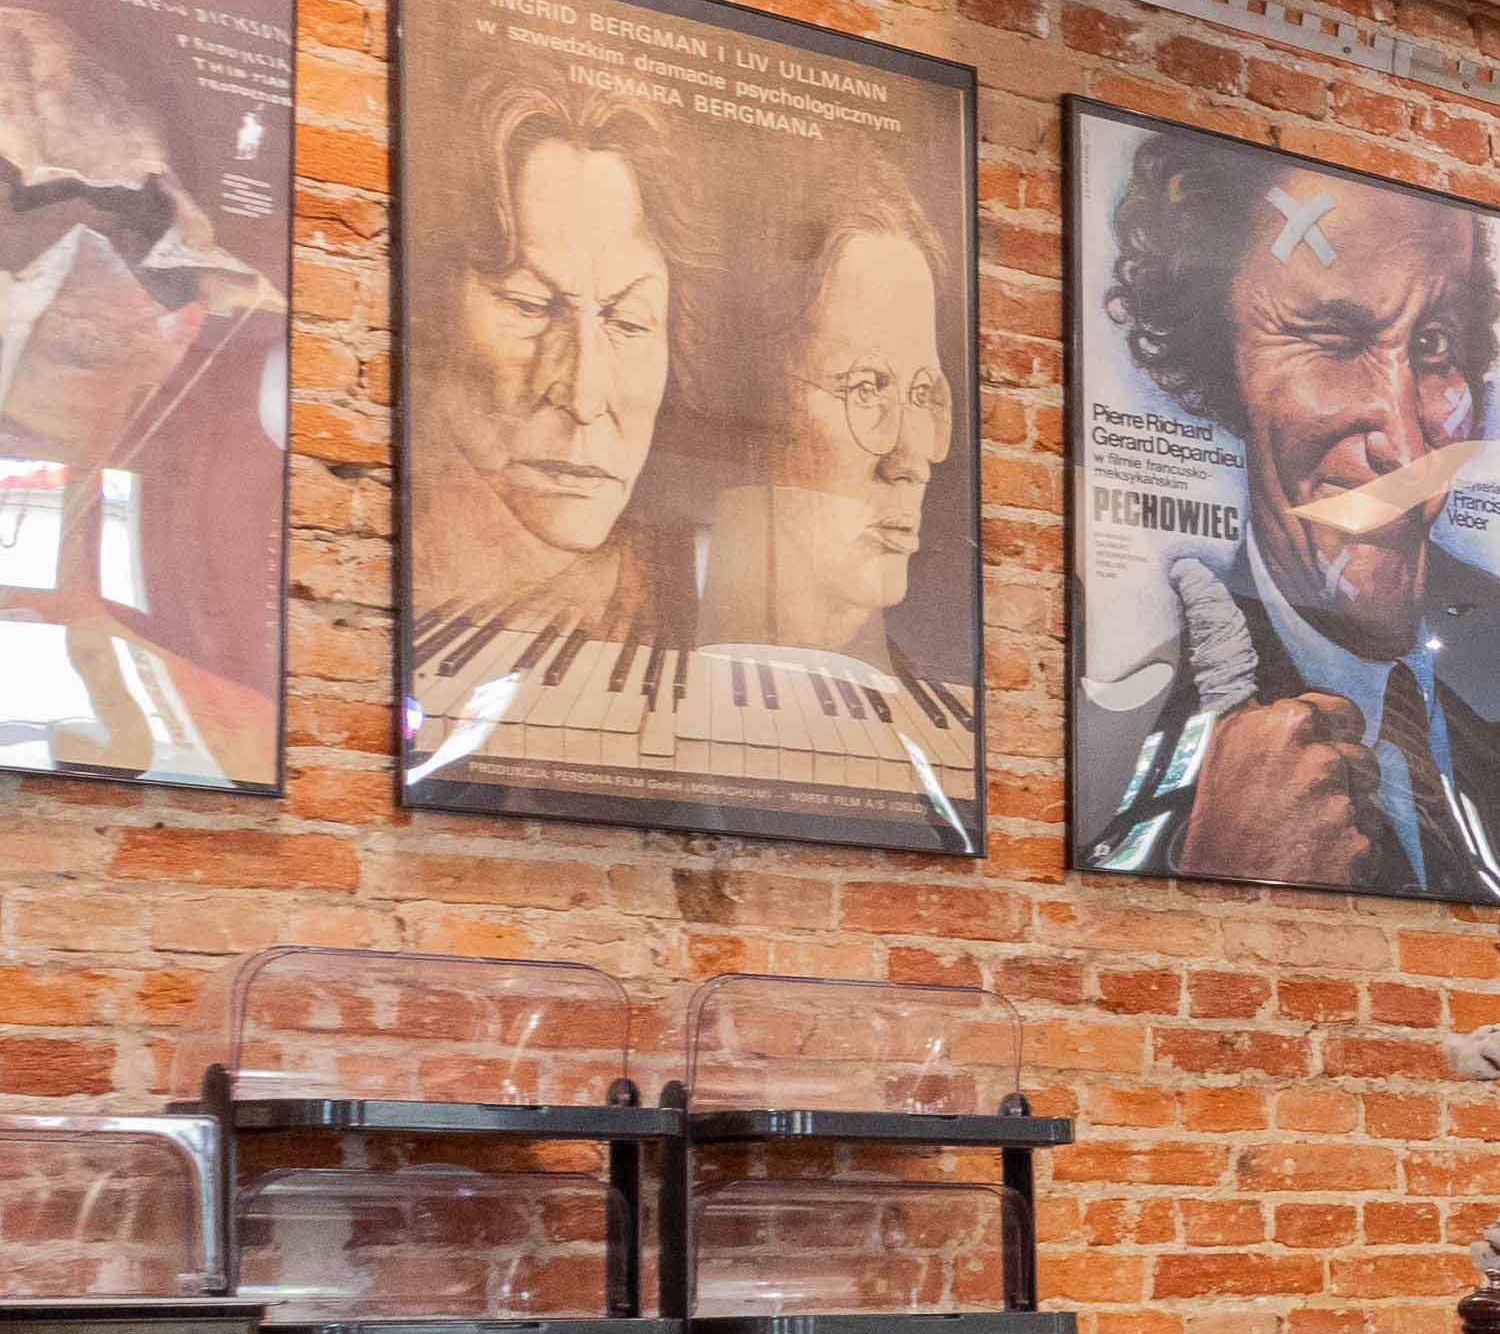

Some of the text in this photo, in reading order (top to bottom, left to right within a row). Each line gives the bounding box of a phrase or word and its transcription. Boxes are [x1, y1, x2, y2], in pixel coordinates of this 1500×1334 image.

[475, 18, 902, 134] w szwedzkim dramacie psychologicznym
[590, 12, 709, 59] BERGMAN
[735, 49, 769, 74] LIV
[779, 61, 889, 104] ULLMANN
[568, 64, 825, 141] INGMARA BERGMANA
[1092, 402, 1214, 442] Pierre Richard
[1092, 426, 1246, 469] Gerard Depardieu
[1107, 452, 1143, 468] filmie
[1093, 485, 1240, 542] PECHOWIEC
[1447, 506, 1489, 531] Veber
